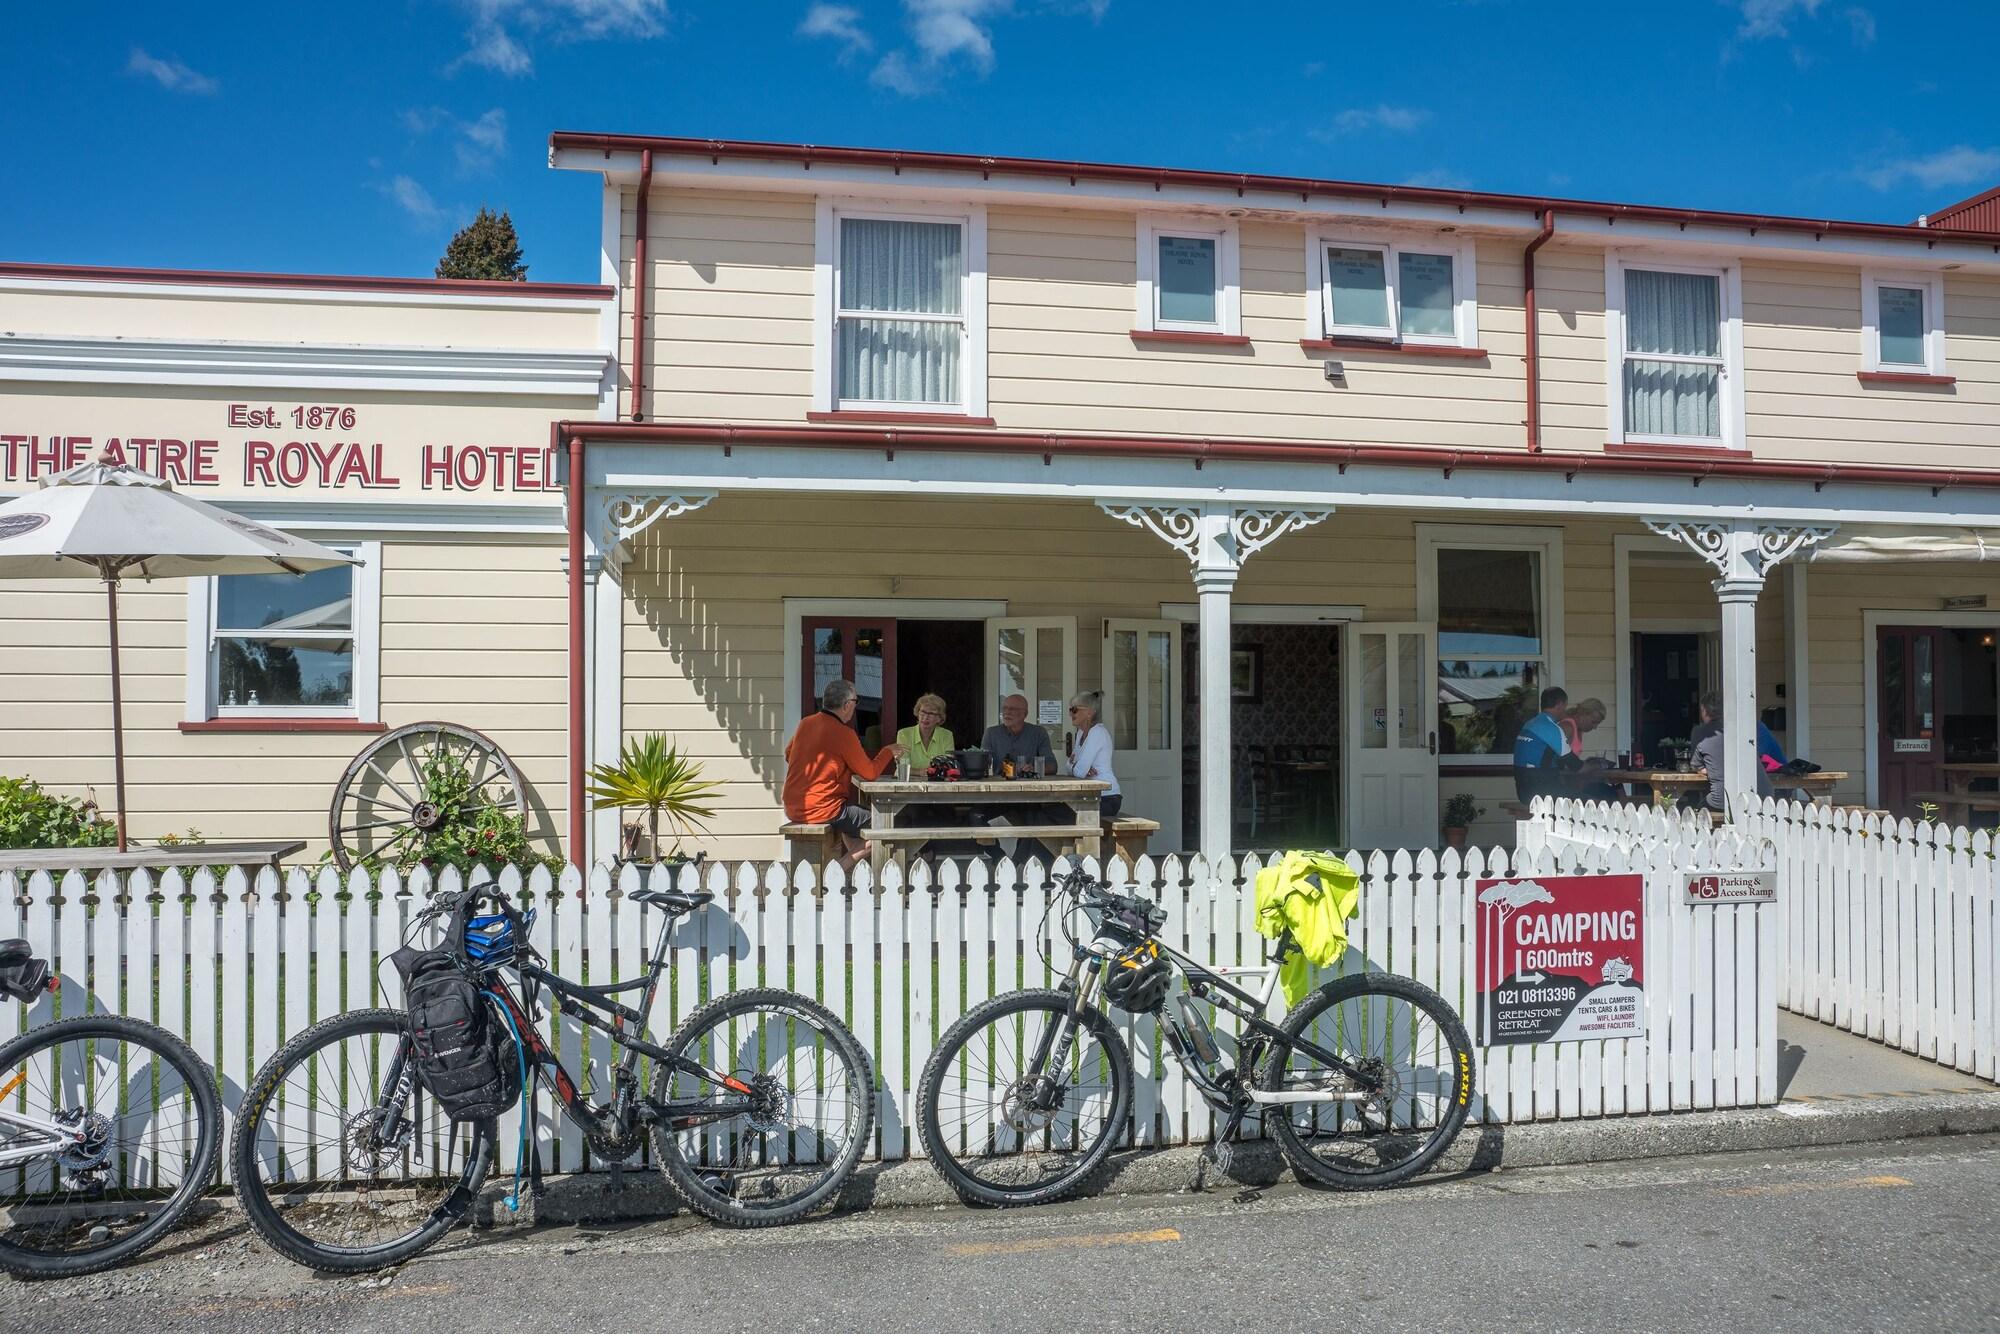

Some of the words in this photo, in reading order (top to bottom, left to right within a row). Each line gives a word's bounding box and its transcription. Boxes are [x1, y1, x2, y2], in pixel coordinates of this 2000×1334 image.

[228, 404, 281, 428] Est.
[291, 405, 356, 430] 1876
[0, 434, 219, 486] THEATRE
[244, 441, 400, 488] ROYAL
[422, 445, 563, 492] HOTEL
[1895, 741, 1929, 750] Entrance
[1720, 878, 1752, 888] Parking
[1754, 877, 1761, 885] &
[1720, 889, 1747, 897] Access
[1749, 887, 1773, 898] Ramp
[1515, 910, 1636, 945] CAMPING
[1526, 948, 1593, 969] 600mtrs
[1499, 990, 1518, 1004] 021
[1522, 987, 1576, 1004] 08113396
[1609, 996, 1636, 1004] CAMPERS
[1498, 1008, 1562, 1020] GREENSTONE
[1598, 1005, 1612, 1013] CARS
[1620, 1004, 1636, 1012] BIKES
[1611, 1013, 1635, 1021] LAUNDRY
[1498, 1020, 1542, 1030] RETREAT
[1580, 1023, 1606, 1031] AWESOME
[1607, 1021, 1636, 1030] FACILITIES
[1459, 1052, 1470, 1105] MAXXIS
[248, 1065, 285, 1129] MAXXIS
